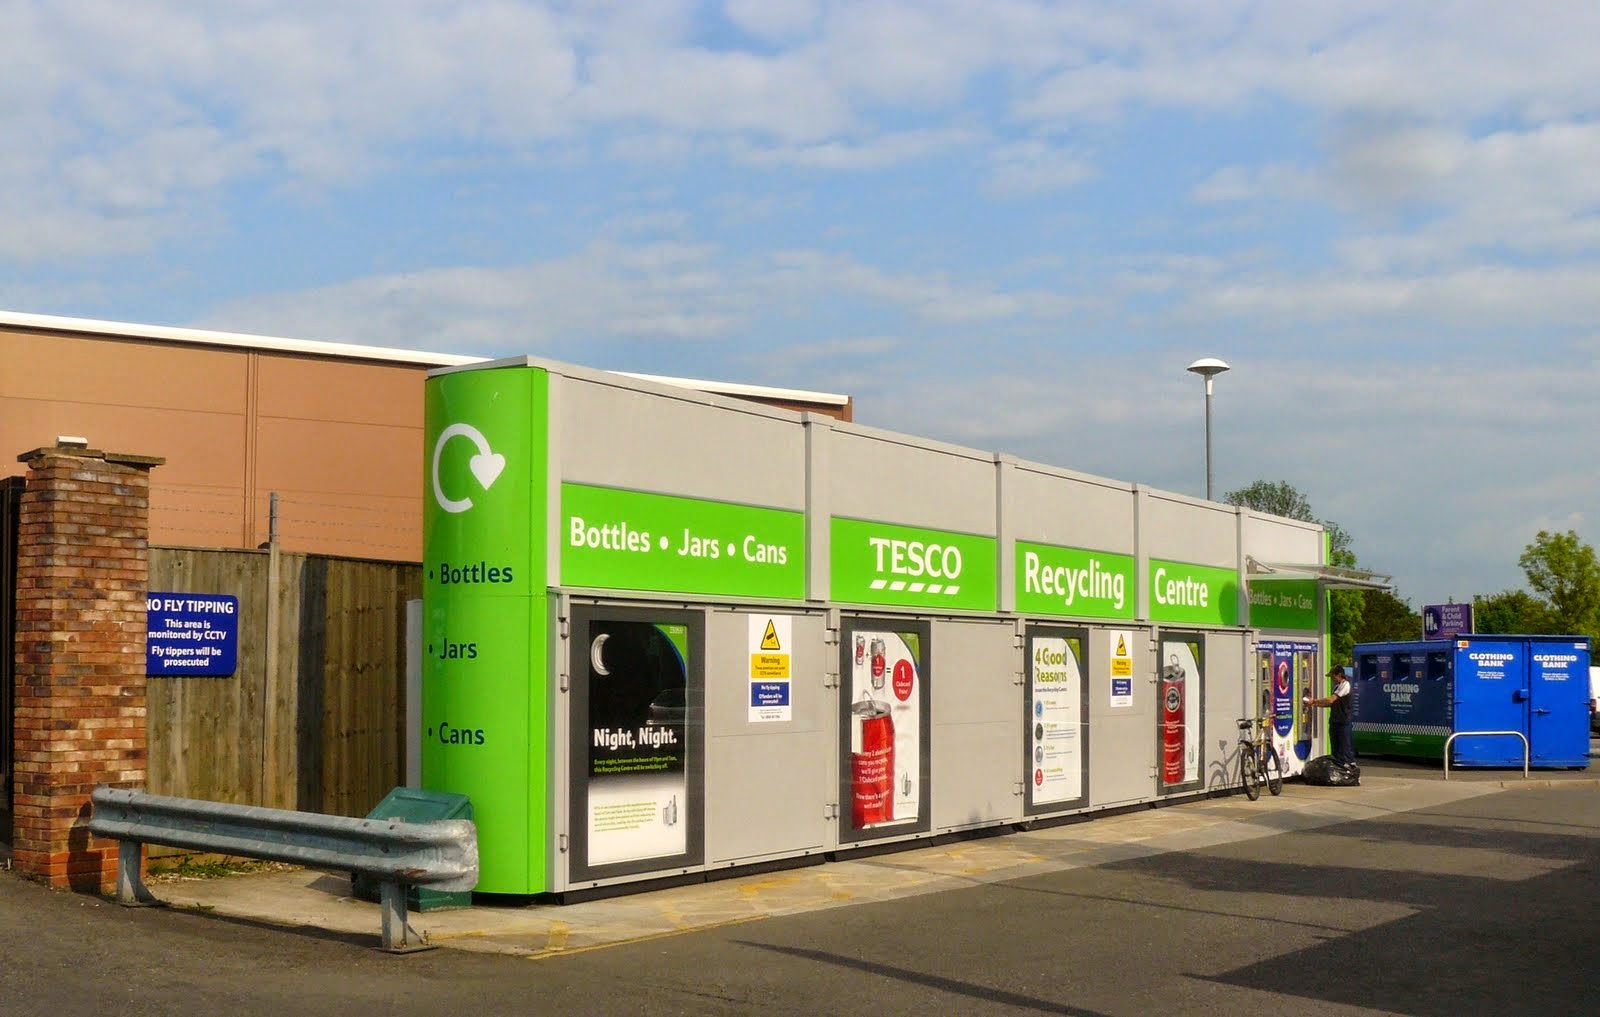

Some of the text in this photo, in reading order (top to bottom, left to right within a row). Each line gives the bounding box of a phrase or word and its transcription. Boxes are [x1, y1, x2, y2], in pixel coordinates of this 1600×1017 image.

[570, 516, 787, 565] Bottles Jars Cans
[869, 537, 962, 579] TESCO
[440, 562, 513, 585] Bottles
[1025, 552, 1125, 609] Recycling
[1154, 568, 1208, 607] Centre
[164, 600, 184, 612] FLY
[186, 600, 234, 614] TIPPING
[1279, 592, 1293, 608] Jars
[1298, 594, 1313, 610] Cans
[165, 619, 211, 629] This area is
[1441, 620, 1464, 628] Parking
[1446, 612, 1462, 620] Child
[148, 630, 226, 641] monitored by CCTV
[151, 646, 222, 657] Fly tippers will be
[439, 638, 478, 659] Jars
[1035, 645, 1068, 667] 4 Good
[164, 658, 209, 668] prosecuted
[761, 656, 781, 665] Warning
[1469, 653, 1514, 661] CLOTHING
[1035, 666, 1067, 684] Reasons
[1383, 684, 1419, 693] CLOTHING
[1391, 693, 1412, 702] BANK
[439, 722, 484, 745] Cans
[593, 726, 677, 750] Night, Night.
